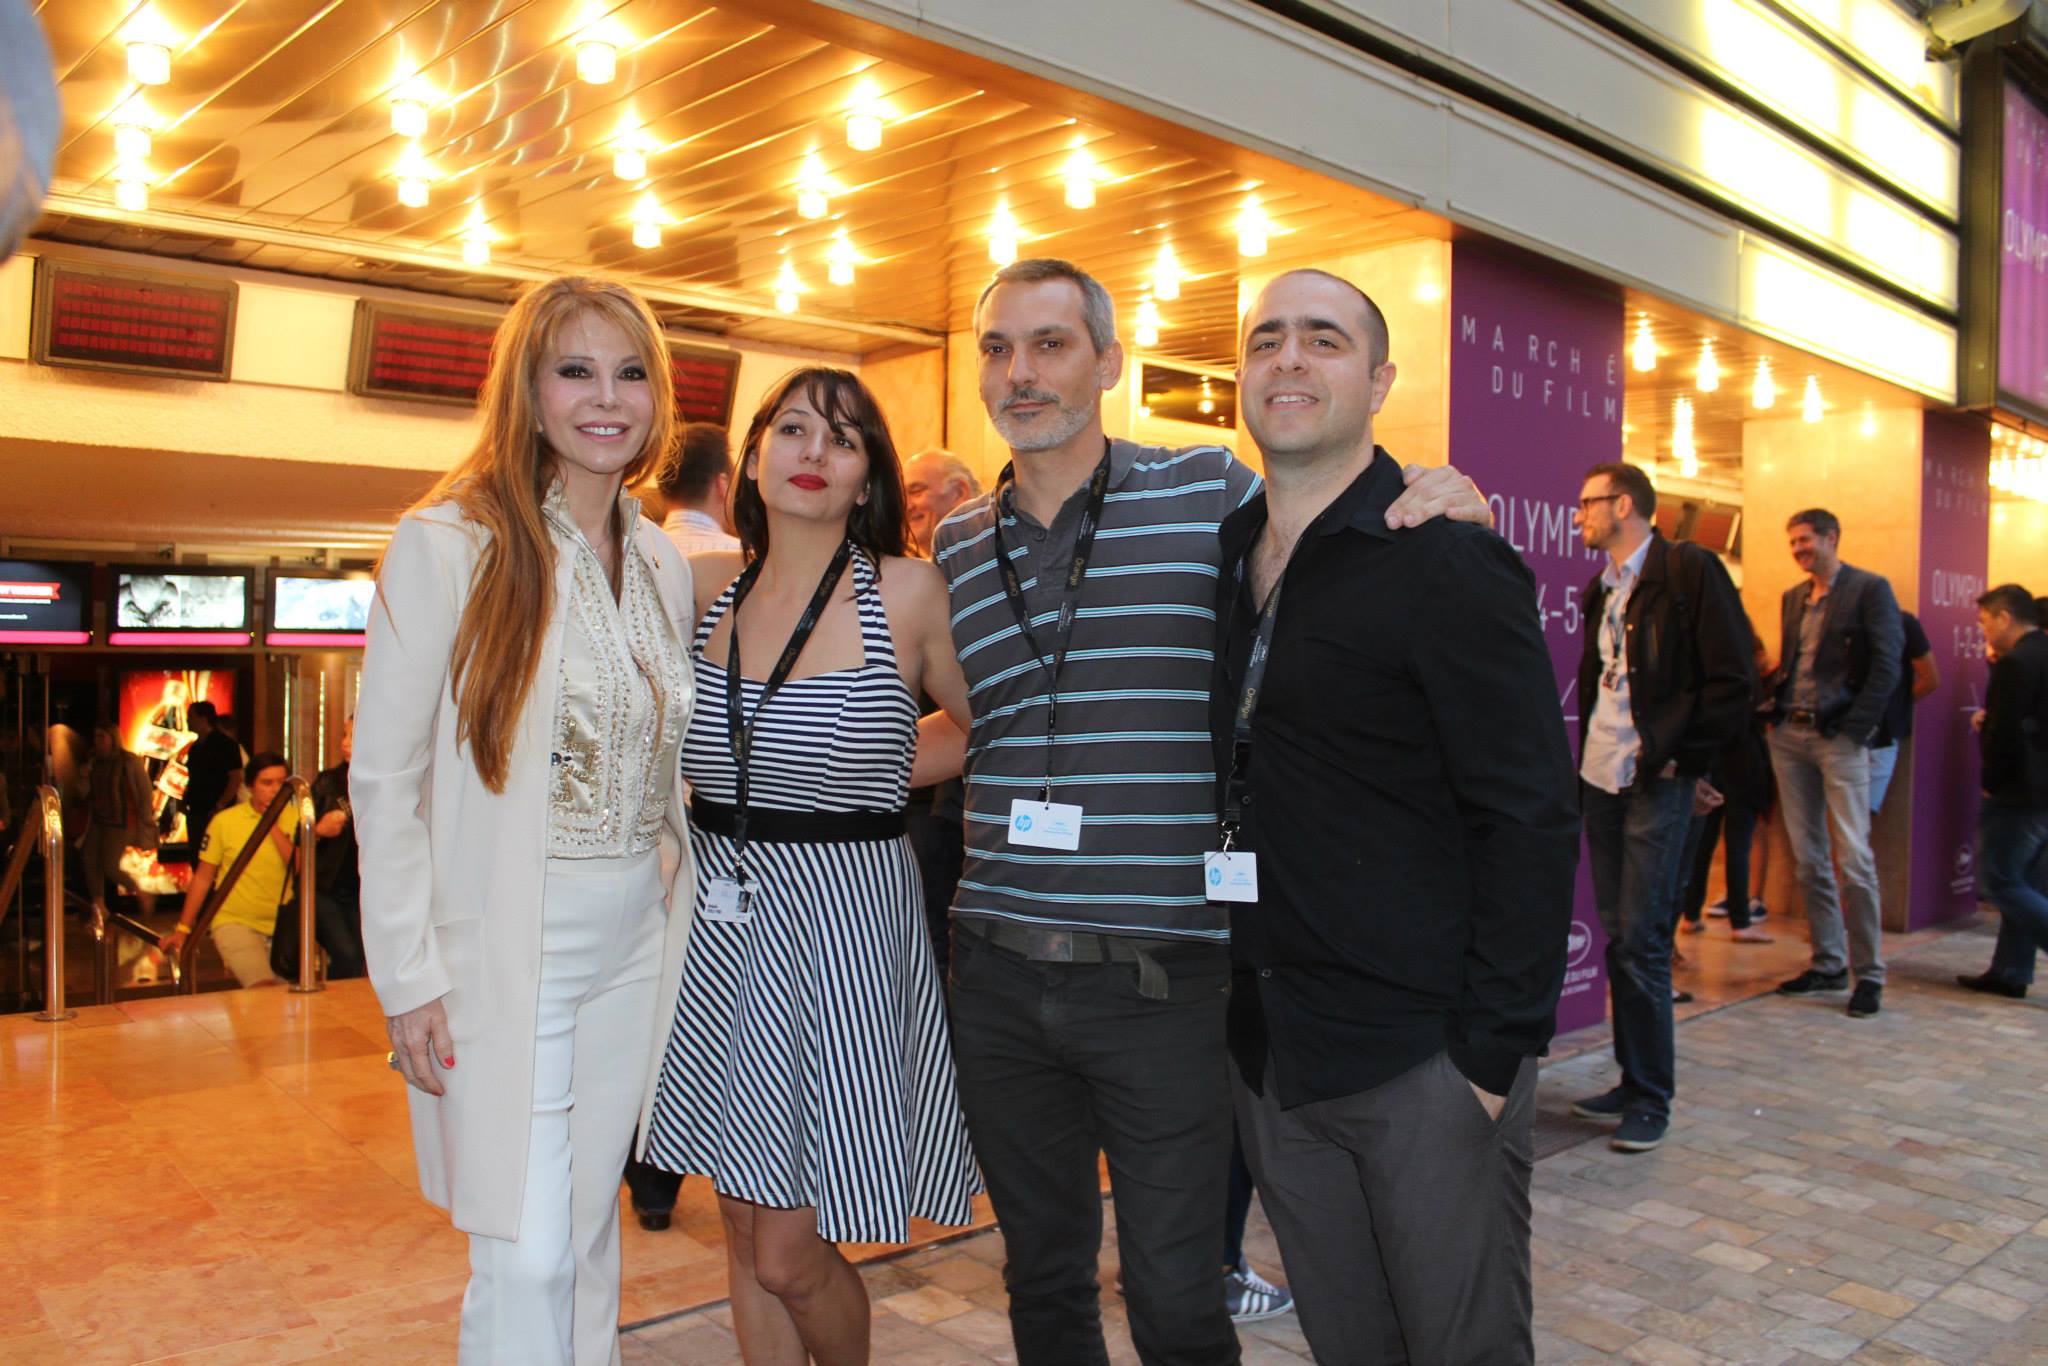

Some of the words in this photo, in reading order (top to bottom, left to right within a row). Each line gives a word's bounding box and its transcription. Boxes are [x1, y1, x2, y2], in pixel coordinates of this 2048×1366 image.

[1461, 314, 1616, 386] MARCHÉ
[1491, 365, 1524, 399] DU
[1544, 378, 1616, 423] FILM
[1488, 493, 1611, 562] OLYMP
[1241, 687, 1256, 720] Orange
